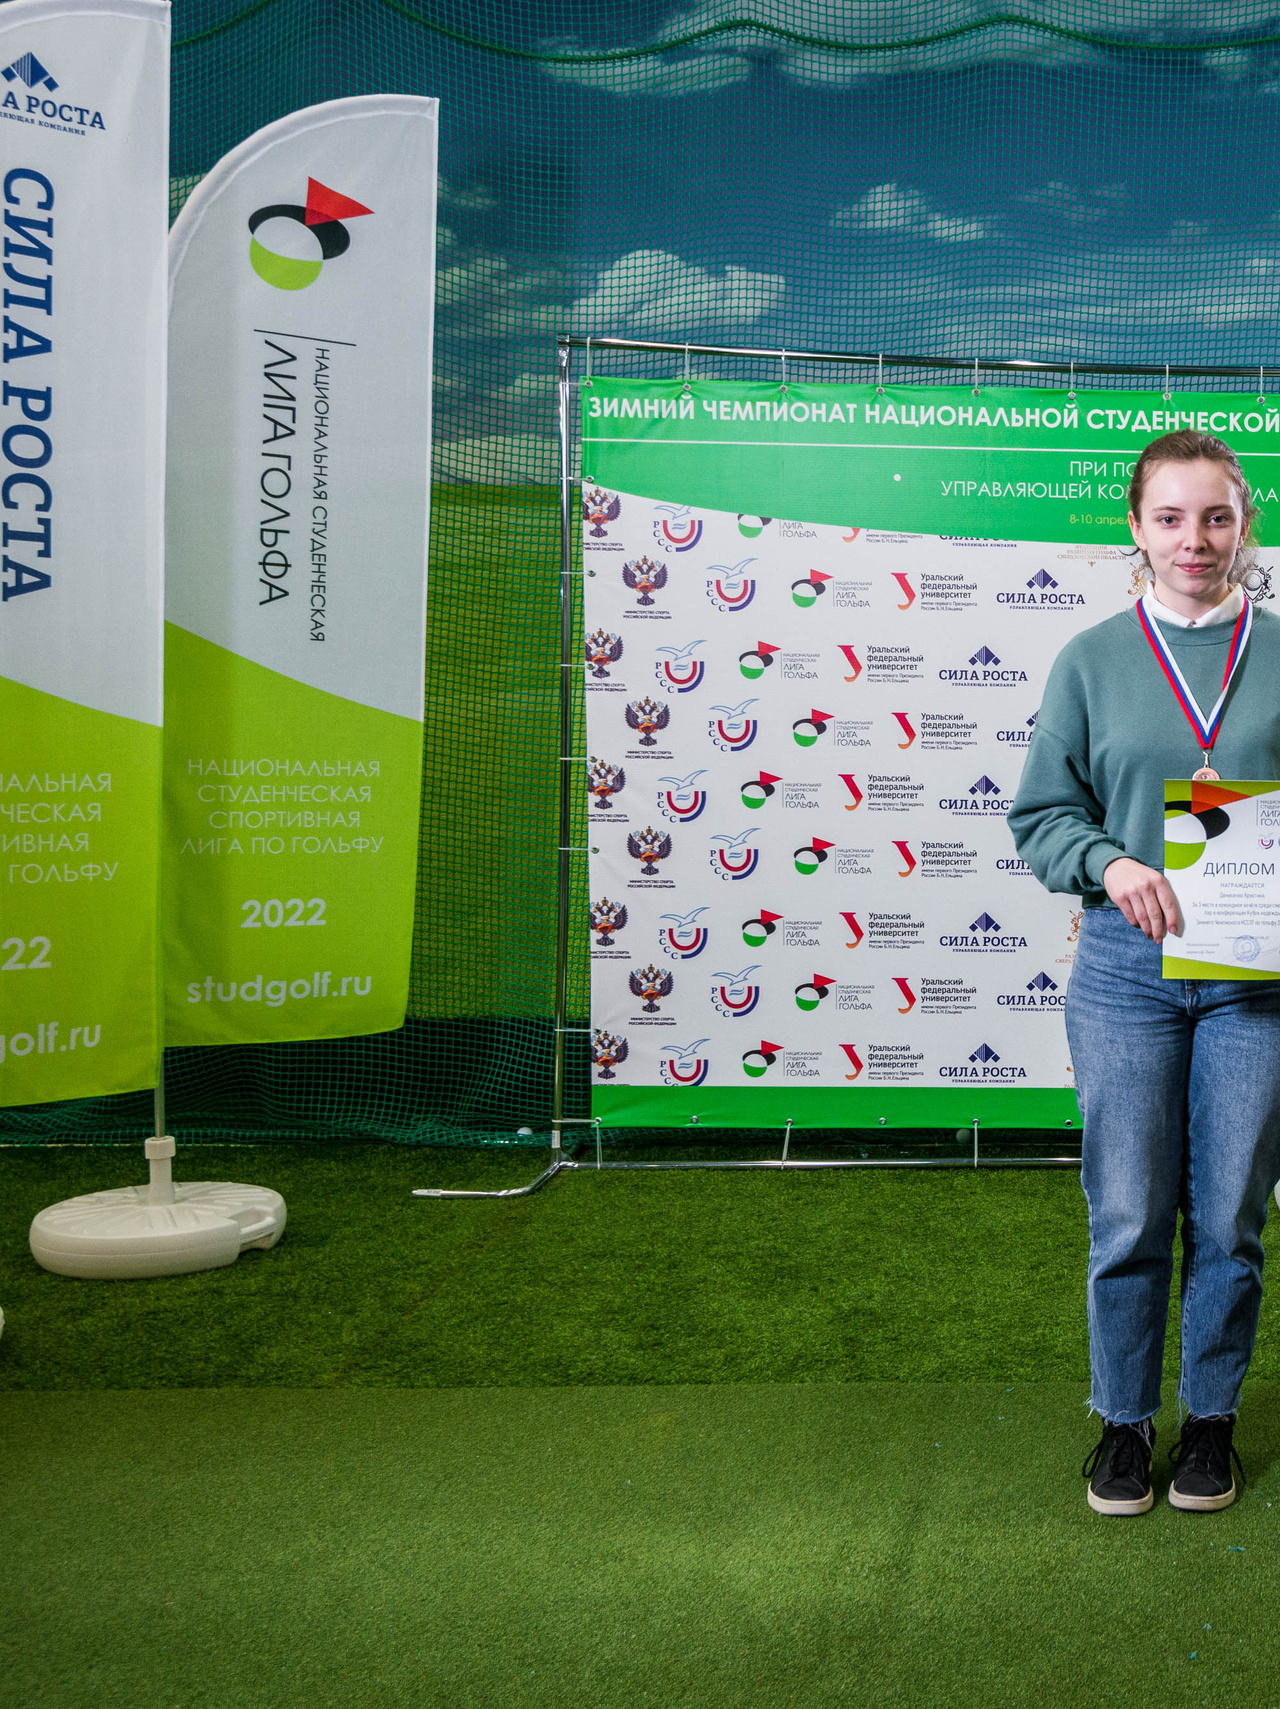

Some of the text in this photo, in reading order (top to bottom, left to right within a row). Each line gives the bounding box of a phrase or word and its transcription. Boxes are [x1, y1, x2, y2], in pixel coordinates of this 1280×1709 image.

[26, 95, 106, 130] РОСТА
[38, 120, 86, 136] КОМПАНИЯ
[2, 168, 55, 363] СИЛА
[588, 394, 695, 420] ЗИМНИЙ
[702, 400, 858, 423] ЧЕМПИОНАТ
[865, 403, 1078, 428] НАЦИОНАЛЬНОЙ
[1086, 408, 1280, 433] СТУДЕНЧЕСКОЙ
[258, 339, 297, 606] ЛИГА ГОЛЬФА
[1070, 461, 1106, 477] ПРИ
[1, 380, 53, 602] РОСТА
[310, 348, 330, 642] НАЦИОНАЛЬНАЯ СТУДЕНЧЕСКАЯ
[941, 481, 1091, 500] УПРАВЛЯЮЩЕЙ
[1252, 488, 1278, 502] ЛА
[1070, 514, 1092, 524] 8-10
[782, 530, 817, 538] ГОЛЬФА
[921, 573, 964, 582] Уральский
[920, 582, 978, 591] федеральный
[921, 591, 971, 599] университет
[996, 593, 1086, 605] СИЛА РОСТА
[867, 645, 910, 654] Уральский
[867, 654, 924, 663] федеральный
[867, 663, 918, 672] университет
[939, 670, 1028, 681] СИЛА РОСТА
[921, 713, 964, 722] Уральский
[921, 722, 978, 731] федеральный
[921, 730, 971, 739] университет
[837, 739, 871, 747] ГОЛЬФА
[187, 758, 380, 778] НАЦИОНАЛЬНАЯ
[0, 773, 112, 793] АЛЬНАЯ
[867, 775, 911, 783] Уральский
[867, 783, 924, 792] федеральный
[197, 784, 372, 805] СТУДЕНЧЕСКАЯ
[867, 792, 919, 800] университет
[939, 799, 979, 810] СИЛА
[209, 811, 361, 829] СПОРТИВНАЯ
[0, 832, 89, 853] ИВНАЯ
[180, 835, 385, 856] ЛИГА ПО ГОЛЬФУ
[921, 841, 964, 850] Уральский
[921, 850, 978, 859] федеральный
[921, 858, 972, 867] университет
[8, 861, 119, 884] ГОЛЬФУ
[1203, 863, 1275, 877] ДИПЛОМ
[240, 898, 327, 929] 2022
[869, 912, 911, 921] Уральский
[868, 921, 925, 930] федеральный
[869, 929, 919, 938] университет
[939, 936, 1028, 947] СИЛА РОСТА
[921, 978, 963, 986] Уральский
[186, 971, 372, 1007] studgolf.ru
[921, 986, 977, 996] федеральный
[921, 995, 971, 1003] университет
[997, 995, 1066, 1006] СИЛА РОС
[868, 1044, 911, 1053] Уральский
[868, 1053, 924, 1062] федеральный
[868, 1061, 918, 1070] университет
[786, 1069, 820, 1077] ГОЛЬФА
[939, 1066, 1027, 1077] СИЛА РОСТА
